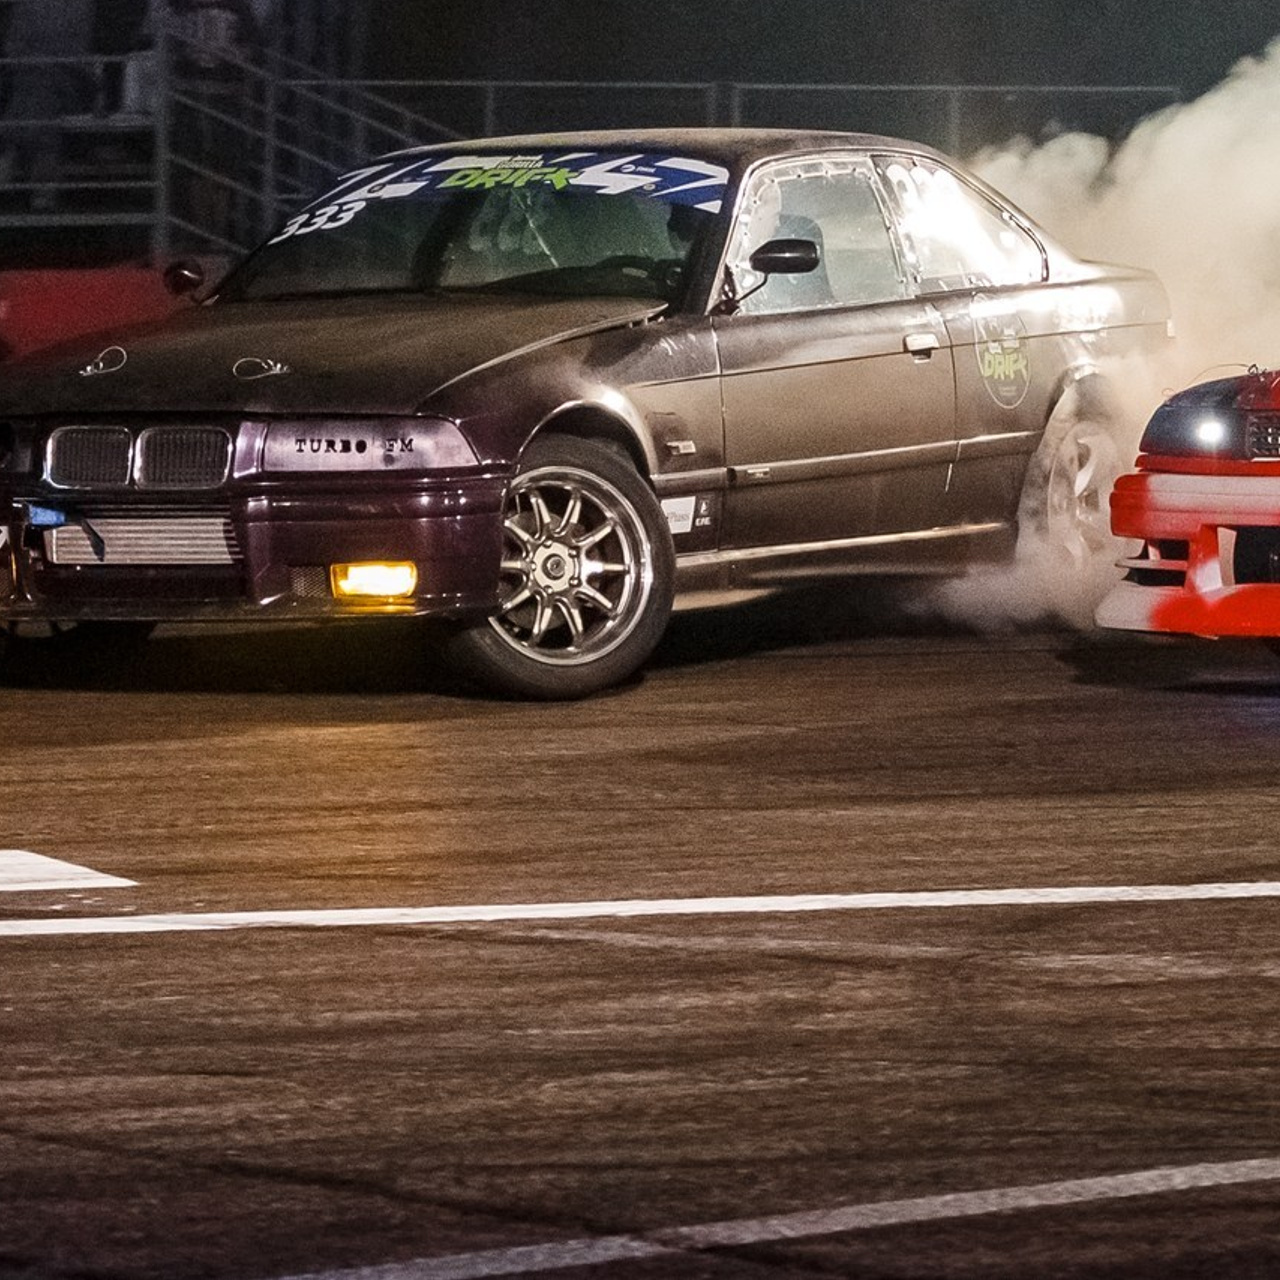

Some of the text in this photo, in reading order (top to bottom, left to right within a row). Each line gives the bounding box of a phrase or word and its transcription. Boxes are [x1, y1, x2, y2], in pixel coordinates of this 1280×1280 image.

[435, 167, 580, 191] DRIFT
[267, 200, 367, 246] 333
[294, 438, 368, 454] TURBO
